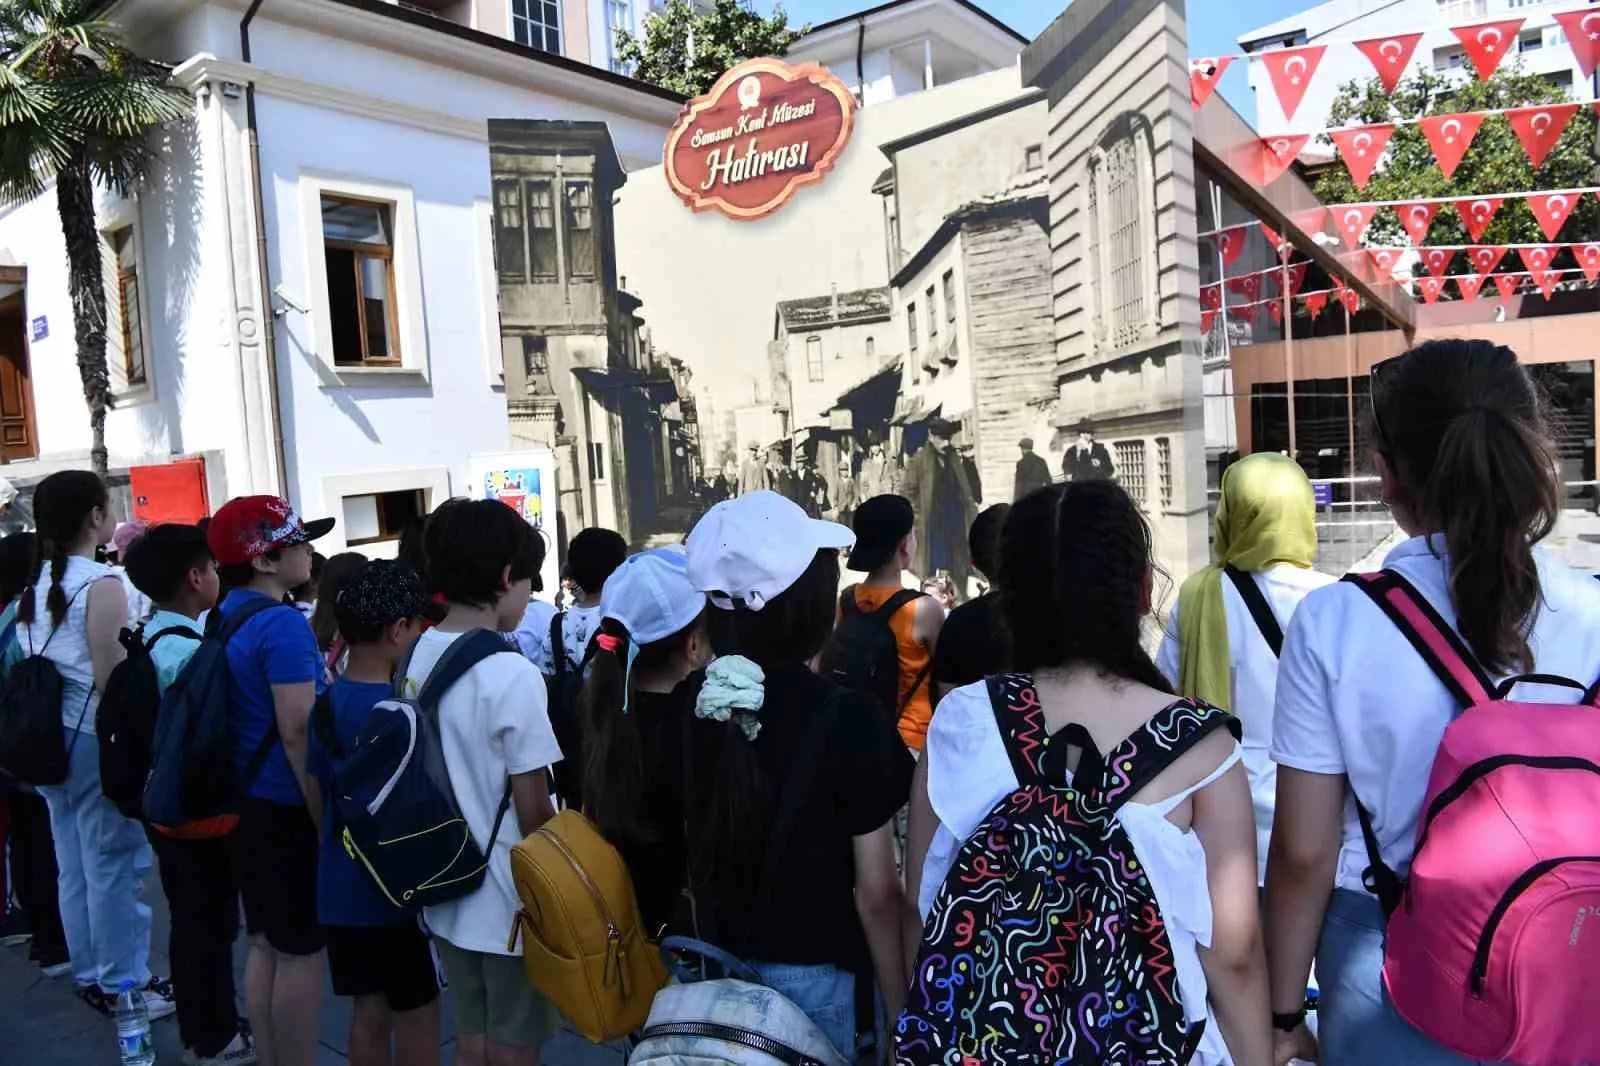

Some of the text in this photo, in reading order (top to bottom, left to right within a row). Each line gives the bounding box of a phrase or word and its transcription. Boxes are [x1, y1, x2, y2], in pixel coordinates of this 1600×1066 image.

[691, 98, 815, 147] Samsun Kent Müzesi
[701, 137, 809, 190] Hatırası
